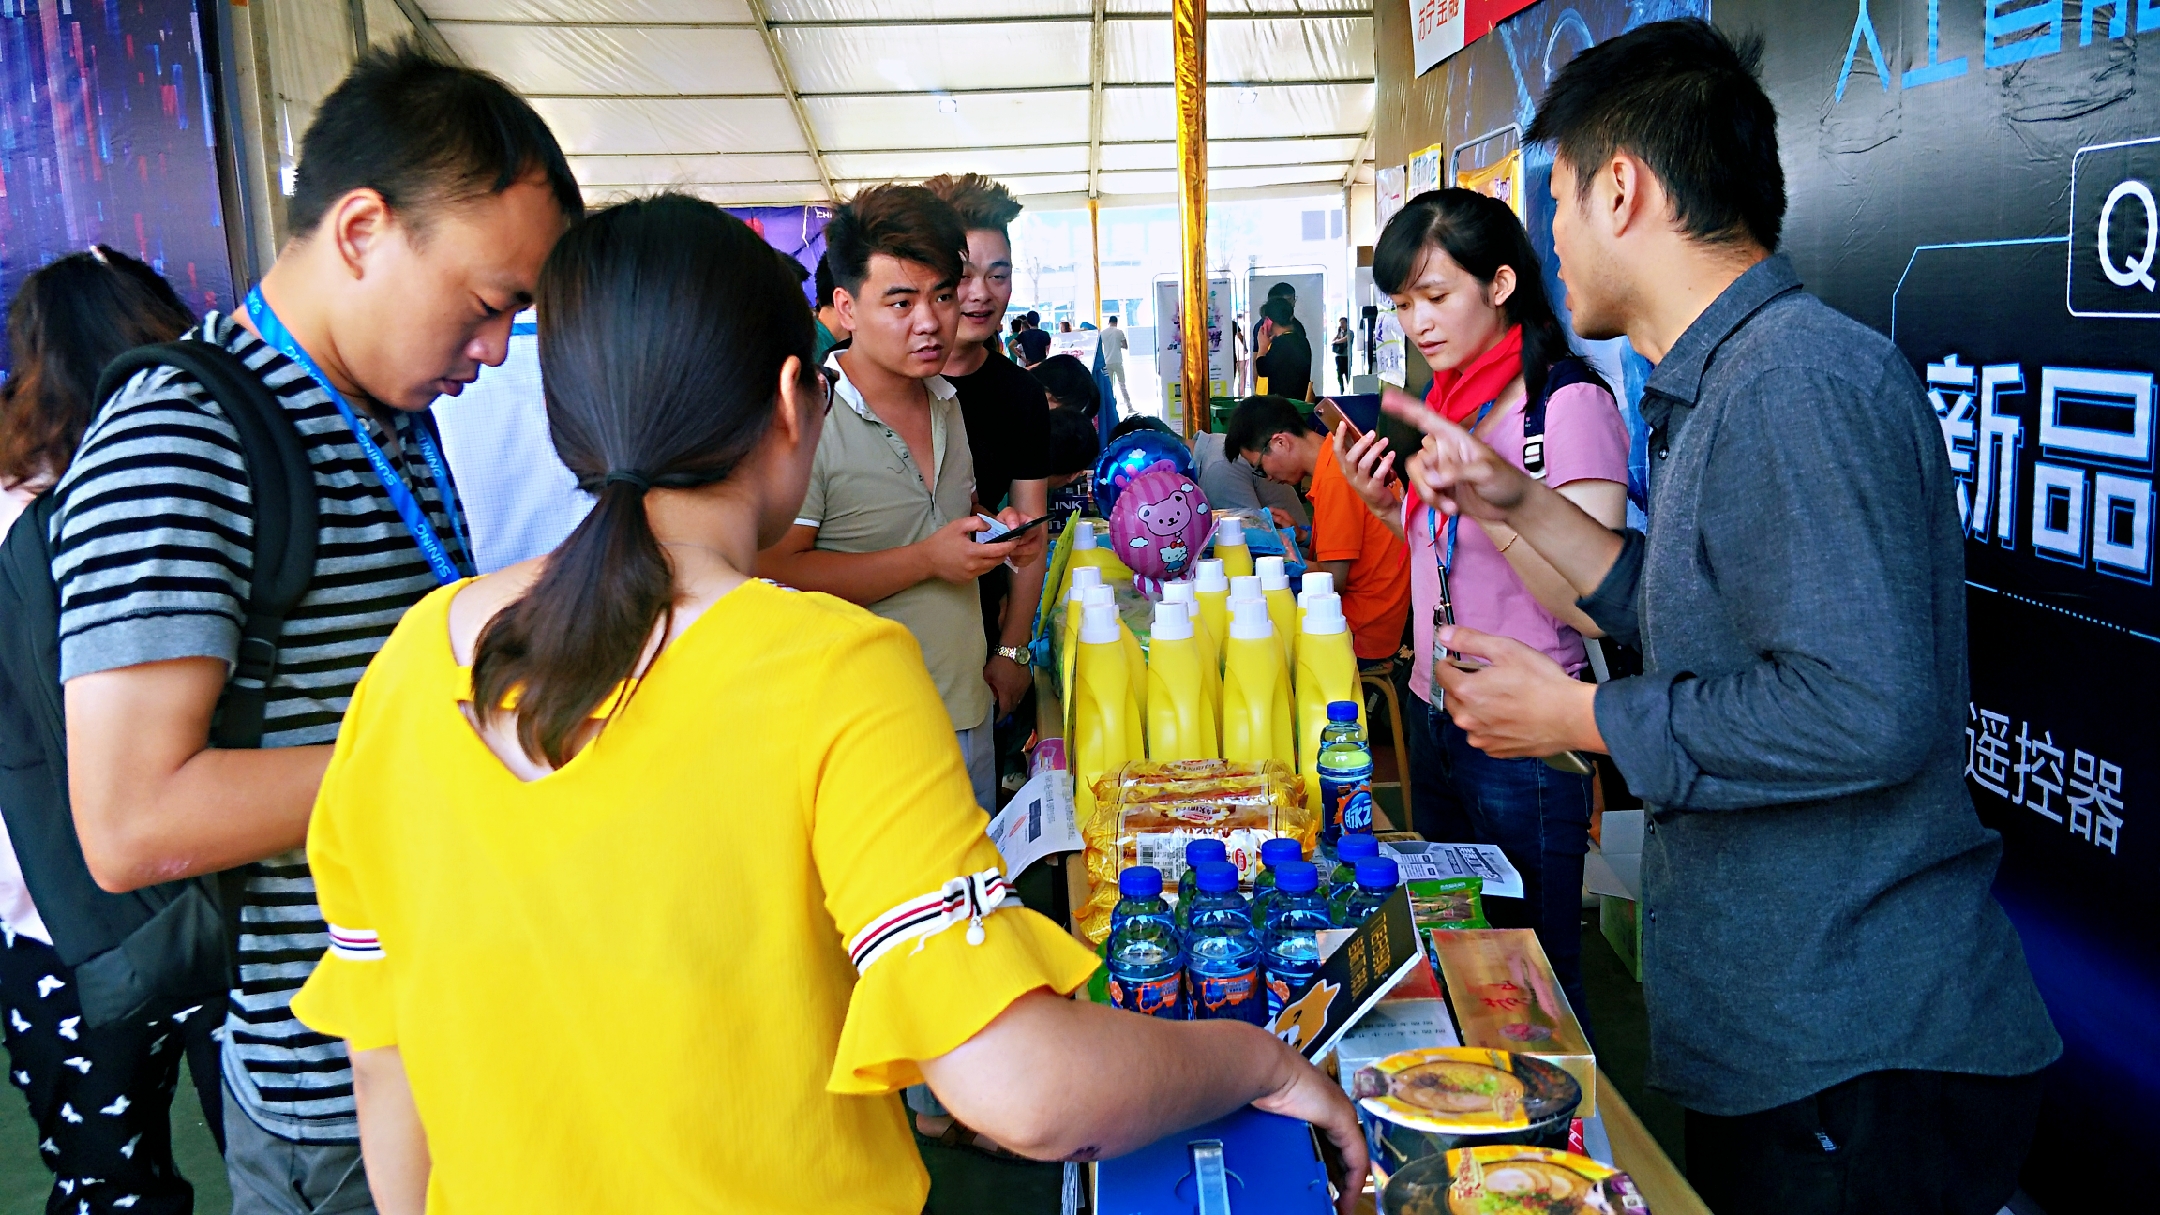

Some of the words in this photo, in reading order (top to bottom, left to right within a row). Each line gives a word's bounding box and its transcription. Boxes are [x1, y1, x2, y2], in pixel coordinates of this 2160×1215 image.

[2097, 180, 2159, 293] Q
[355, 432, 398, 486] SUNING
[1927, 354, 2157, 584] 新品
[414, 523, 452, 578] SUNING
[1964, 701, 2124, 856] 遥控器
